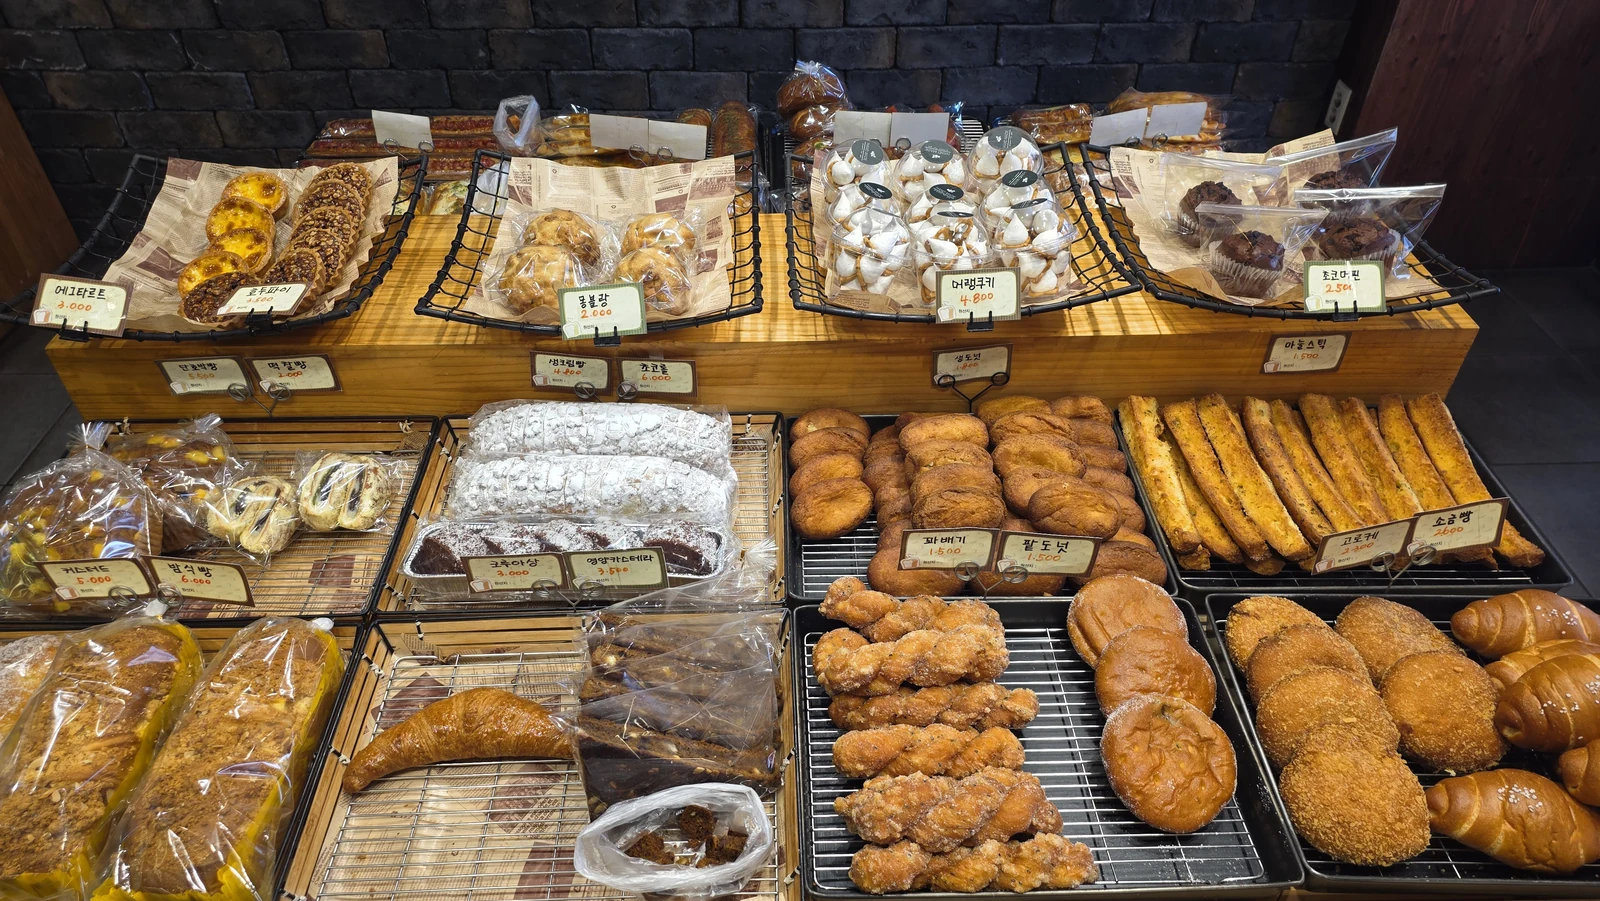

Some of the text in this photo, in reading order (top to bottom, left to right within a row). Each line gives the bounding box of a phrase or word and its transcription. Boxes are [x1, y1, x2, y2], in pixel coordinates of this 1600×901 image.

[1322, 270, 1360, 281] 초코머핀
[951, 276, 995, 290] 머랭쿠키
[55, 286, 106, 300] 에그타르트
[246, 286, 292, 296] 호두파이
[578, 293, 610, 308] 몽블랑
[960, 292, 994, 306] 4.800
[58, 300, 92, 311] 3.000
[580, 309, 612, 319] 2.000
[178, 362, 218, 371] 단호박빵
[548, 358, 587, 368] 생크림빵
[640, 362, 669, 376] 초코롤
[1432, 510, 1473, 527] 소금빵
[923, 536, 966, 545] 꽈배기
[1340, 530, 1380, 547] 고로케
[929, 547, 961, 556] 1.500
[1022, 539, 1070, 554] 팥도넛
[587, 554, 654, 565] 영양카스테라
[1027, 552, 1062, 562] 1.500
[490, 558, 540, 568] 크루아상
[61, 565, 110, 574] 커스터드
[167, 563, 212, 578] 밤식빵
[597, 567, 629, 575] 3.500
[76, 575, 112, 585] 5.000
[181, 575, 211, 585] 6.000
